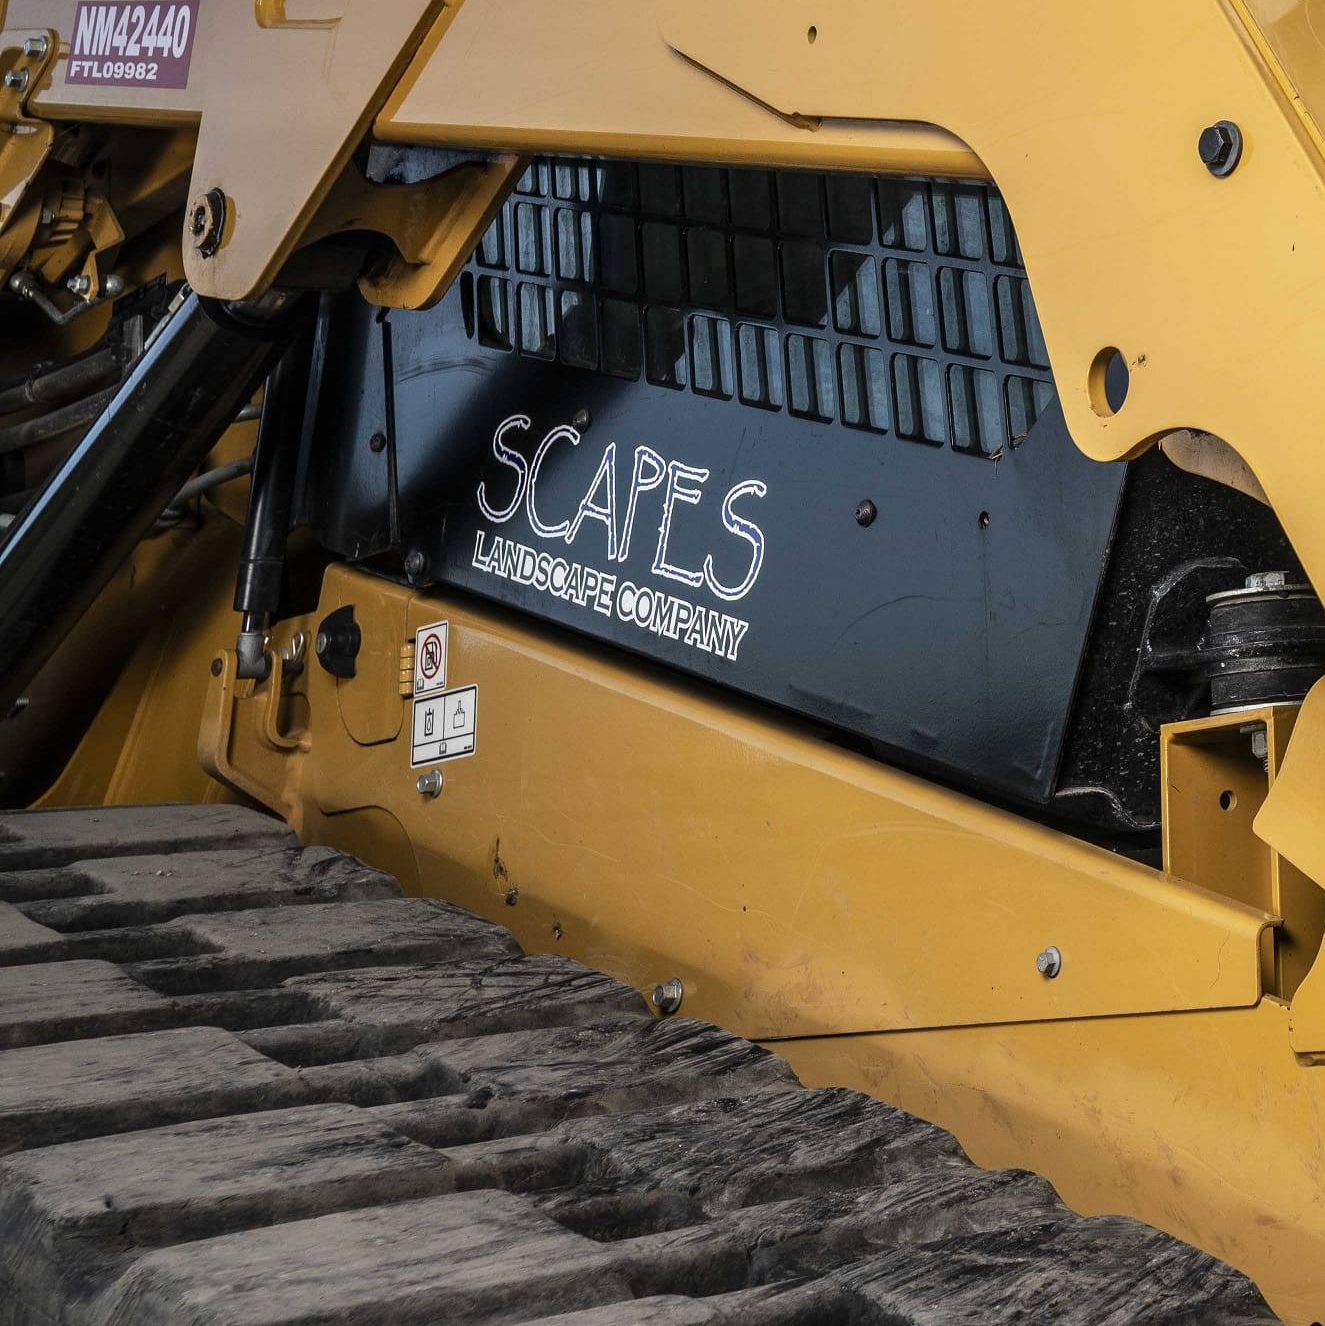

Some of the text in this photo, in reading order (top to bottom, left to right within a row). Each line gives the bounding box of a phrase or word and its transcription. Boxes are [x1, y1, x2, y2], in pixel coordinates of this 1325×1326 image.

[70, 61, 158, 80] FTL09982
[73, 5, 191, 59] NM42440
[477, 414, 767, 602] SCAPES
[471, 530, 749, 661] LANDSCAPE COMPANY
